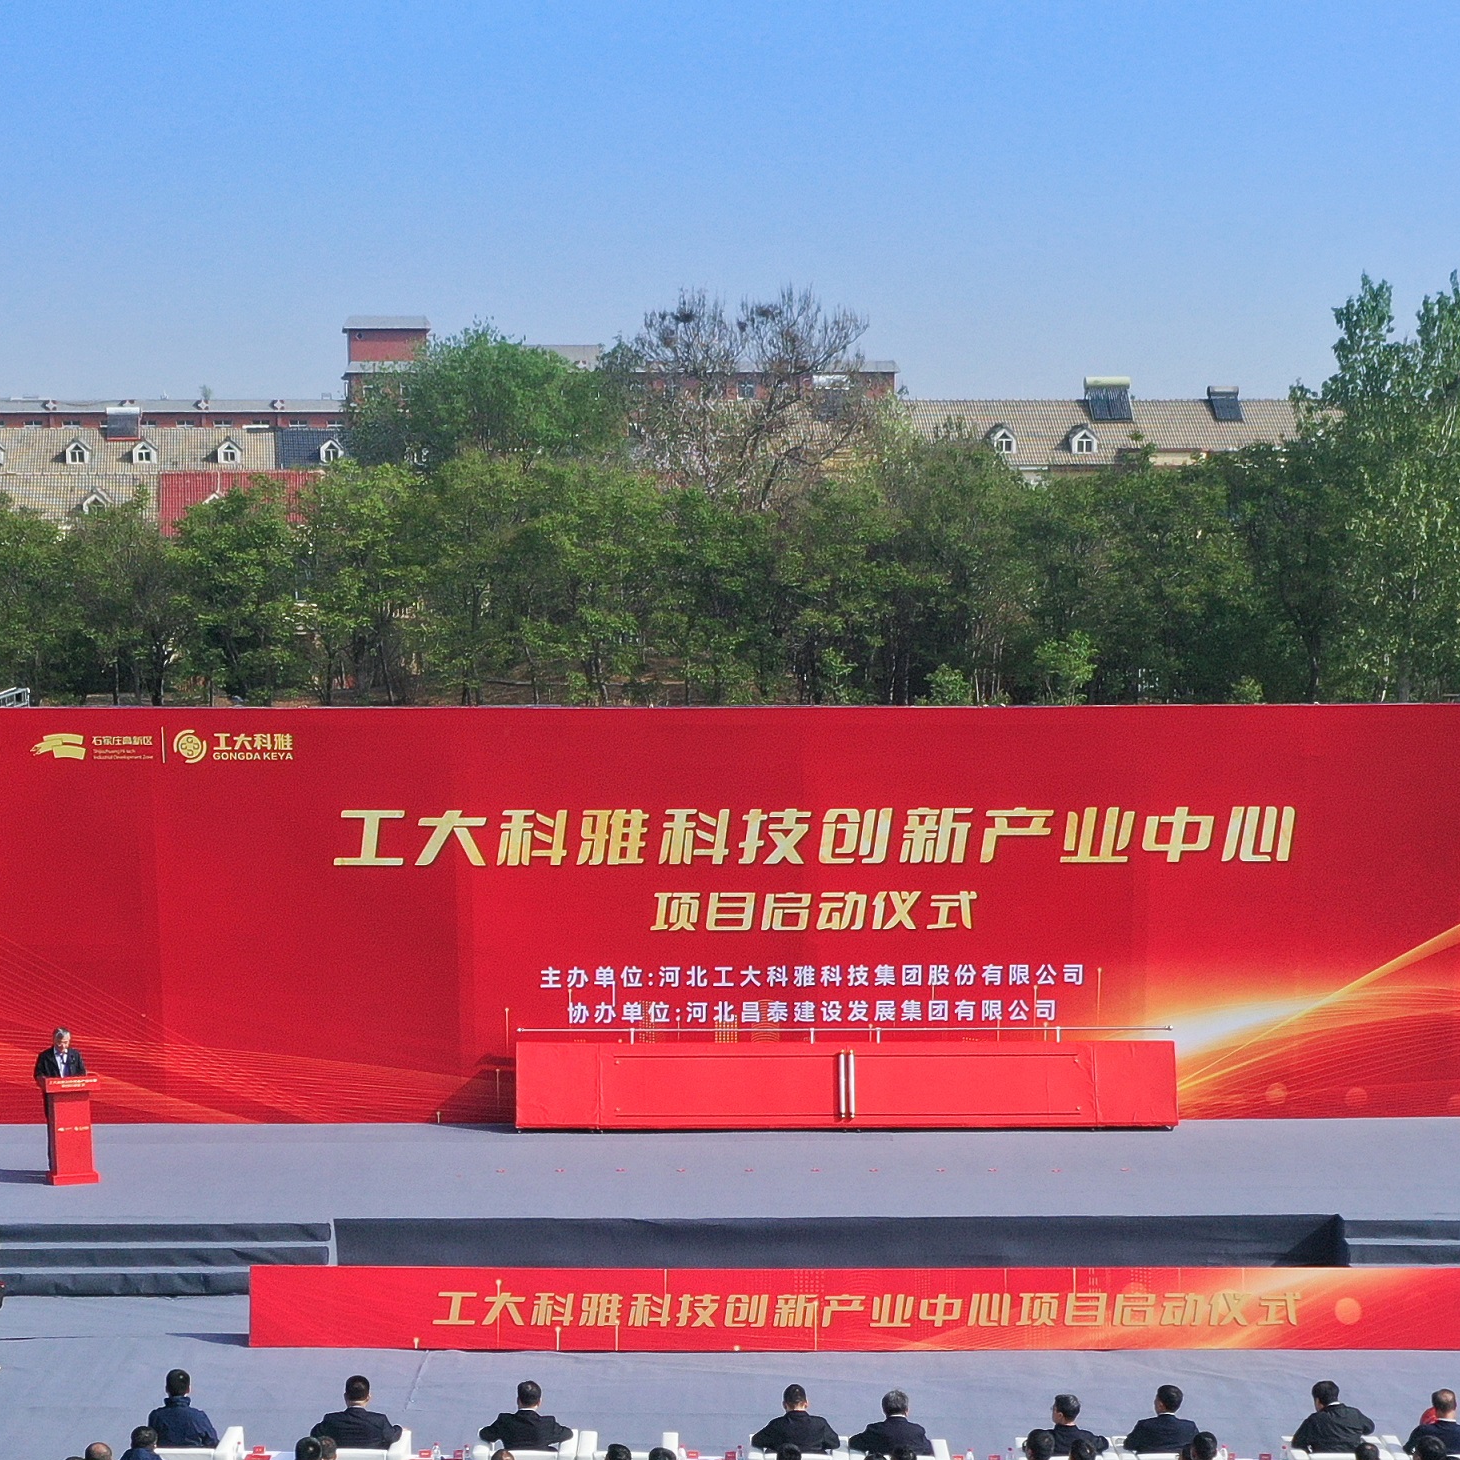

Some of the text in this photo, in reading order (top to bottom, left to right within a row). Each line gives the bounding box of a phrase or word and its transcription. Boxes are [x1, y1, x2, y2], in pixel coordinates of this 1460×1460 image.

[92, 735, 153, 746] 石家庄高新区
[213, 733, 294, 751] 工大科雅
[212, 752, 294, 761] GONGDA KEYA
[332, 804, 1297, 868] 工大科雅科技创新产业中心
[649, 890, 979, 932] 项目启动仪式
[431, 1290, 1304, 1328] 工大科雅科技创新产业中心项目启动仪式
